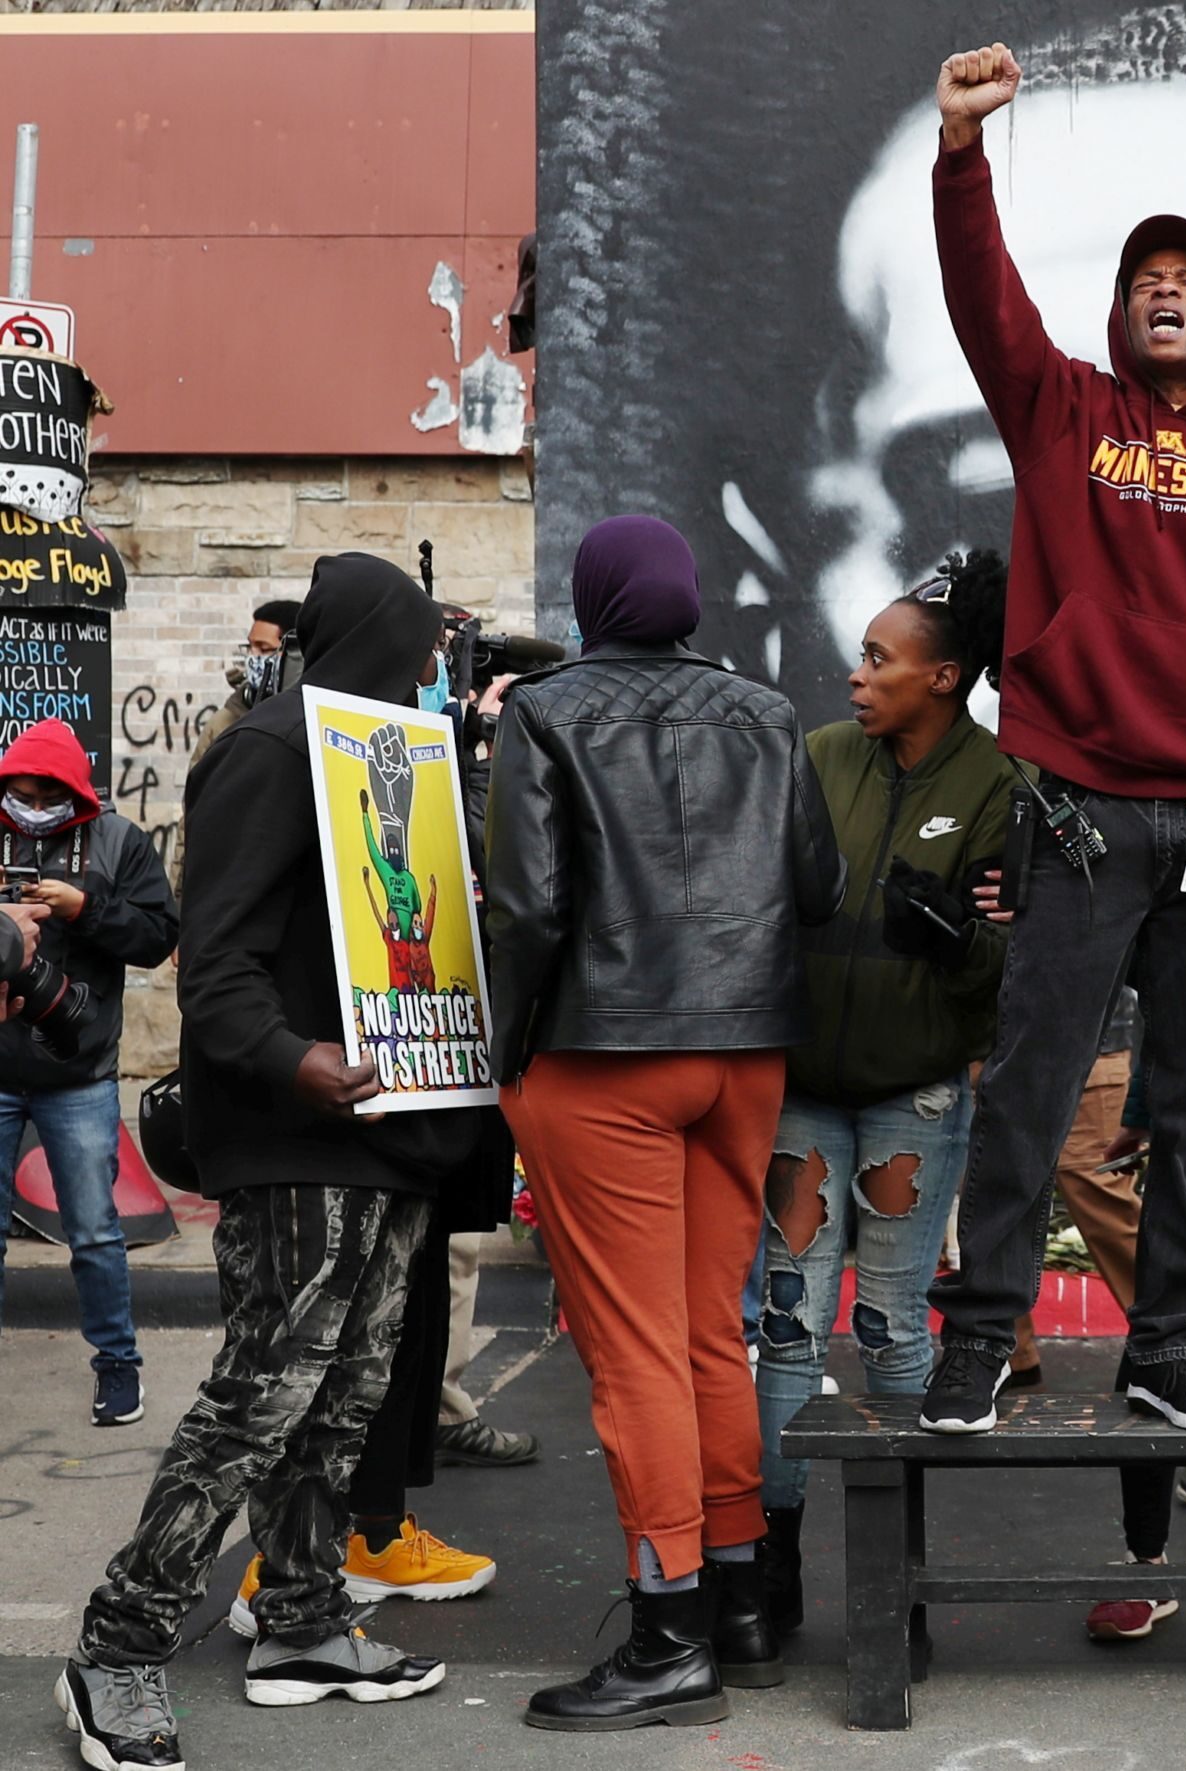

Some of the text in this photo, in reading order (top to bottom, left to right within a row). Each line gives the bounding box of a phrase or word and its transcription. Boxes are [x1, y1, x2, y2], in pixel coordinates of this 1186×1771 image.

[50, 549, 112, 596] Floyd
[0, 616, 28, 640] ACT
[326, 729, 333, 742] E
[927, 816, 956, 830] NIKE
[361, 994, 479, 1036] NO JUSTICE
[396, 1041, 491, 1088] STREETS
